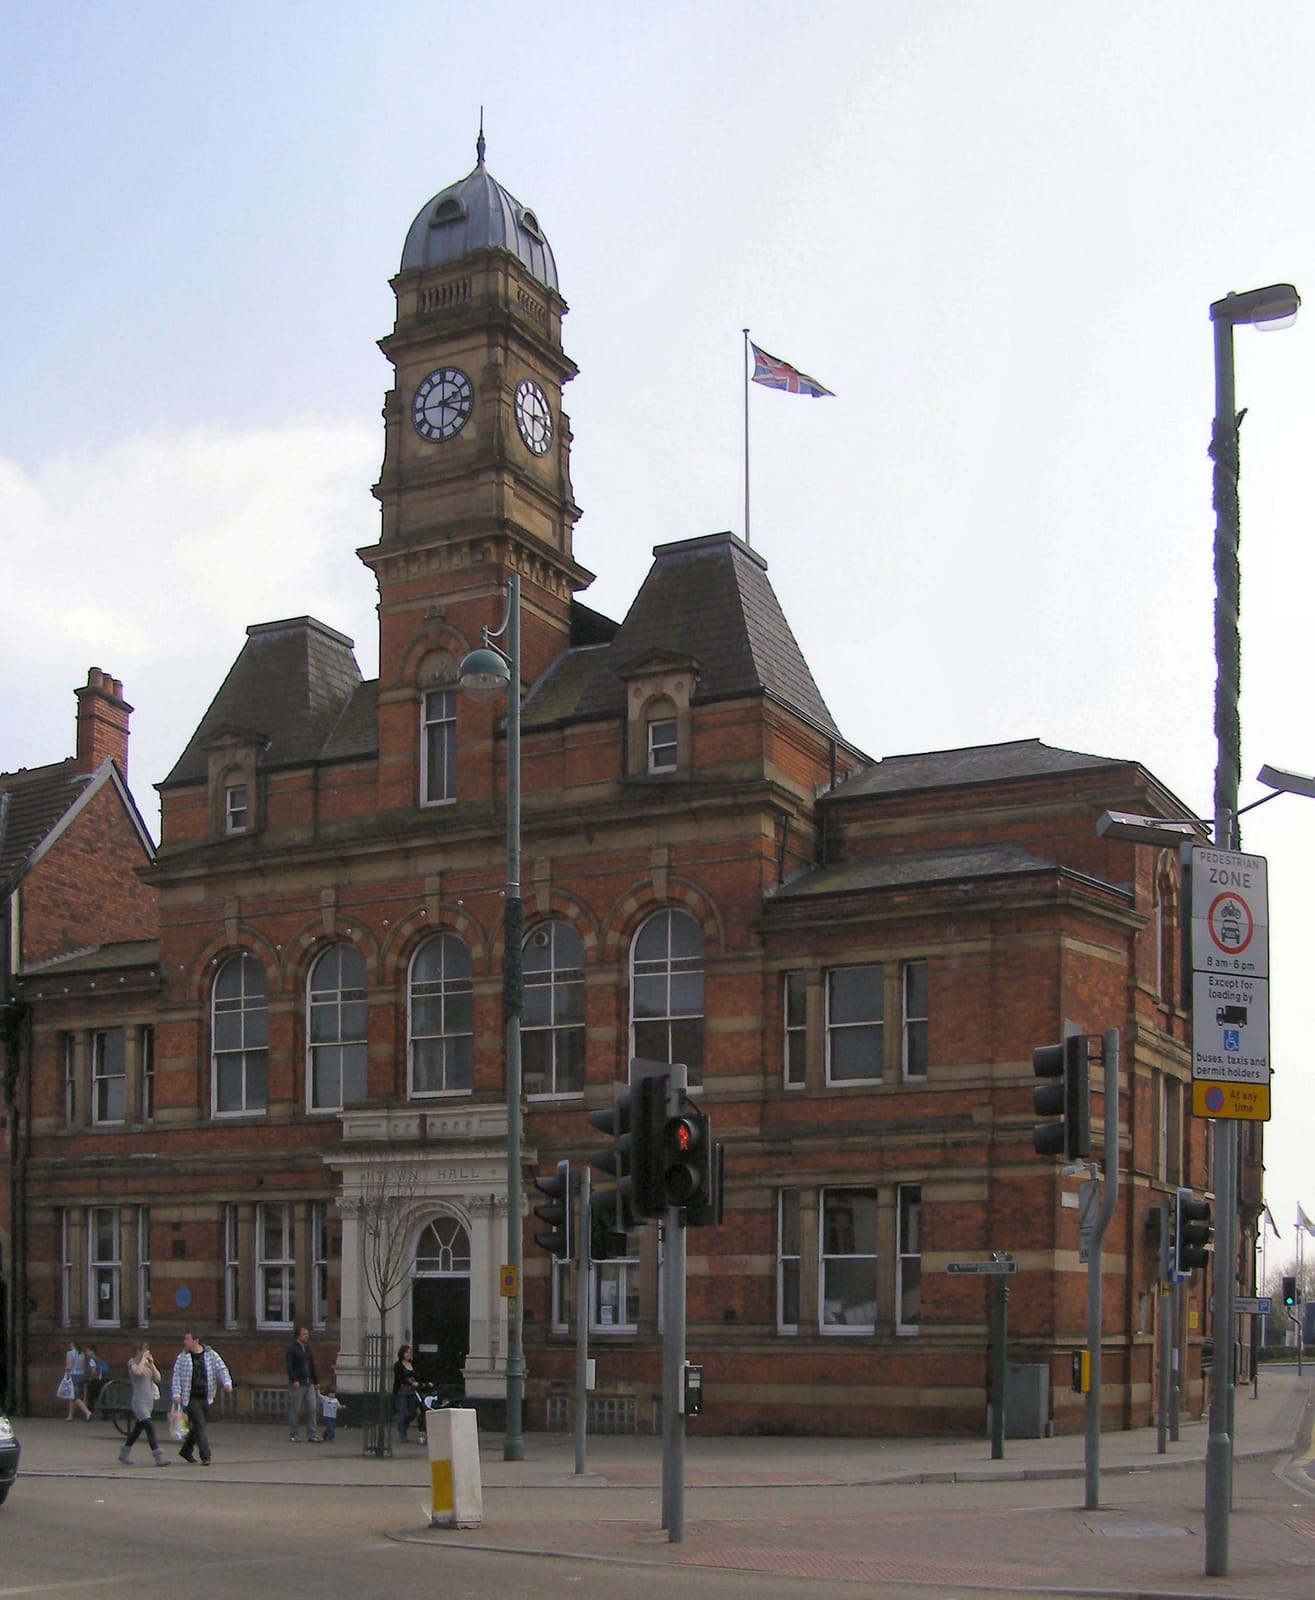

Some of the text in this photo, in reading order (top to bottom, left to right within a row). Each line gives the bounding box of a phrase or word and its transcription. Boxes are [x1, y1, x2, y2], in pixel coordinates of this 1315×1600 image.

[1200, 851, 1259, 869] PEDESTRIAN
[1209, 868, 1251, 888] ZONE
[1208, 976, 1253, 989] Except for
[1208, 989, 1253, 1003] loading by
[1227, 1055, 1248, 1066] taxis
[1250, 1056, 1266, 1067] and
[1196, 1066, 1260, 1079] permit holders
[1230, 1089, 1257, 1103] At any
[1234, 1103, 1254, 1112] time
[376, 1168, 480, 1181] TOWN HALL
